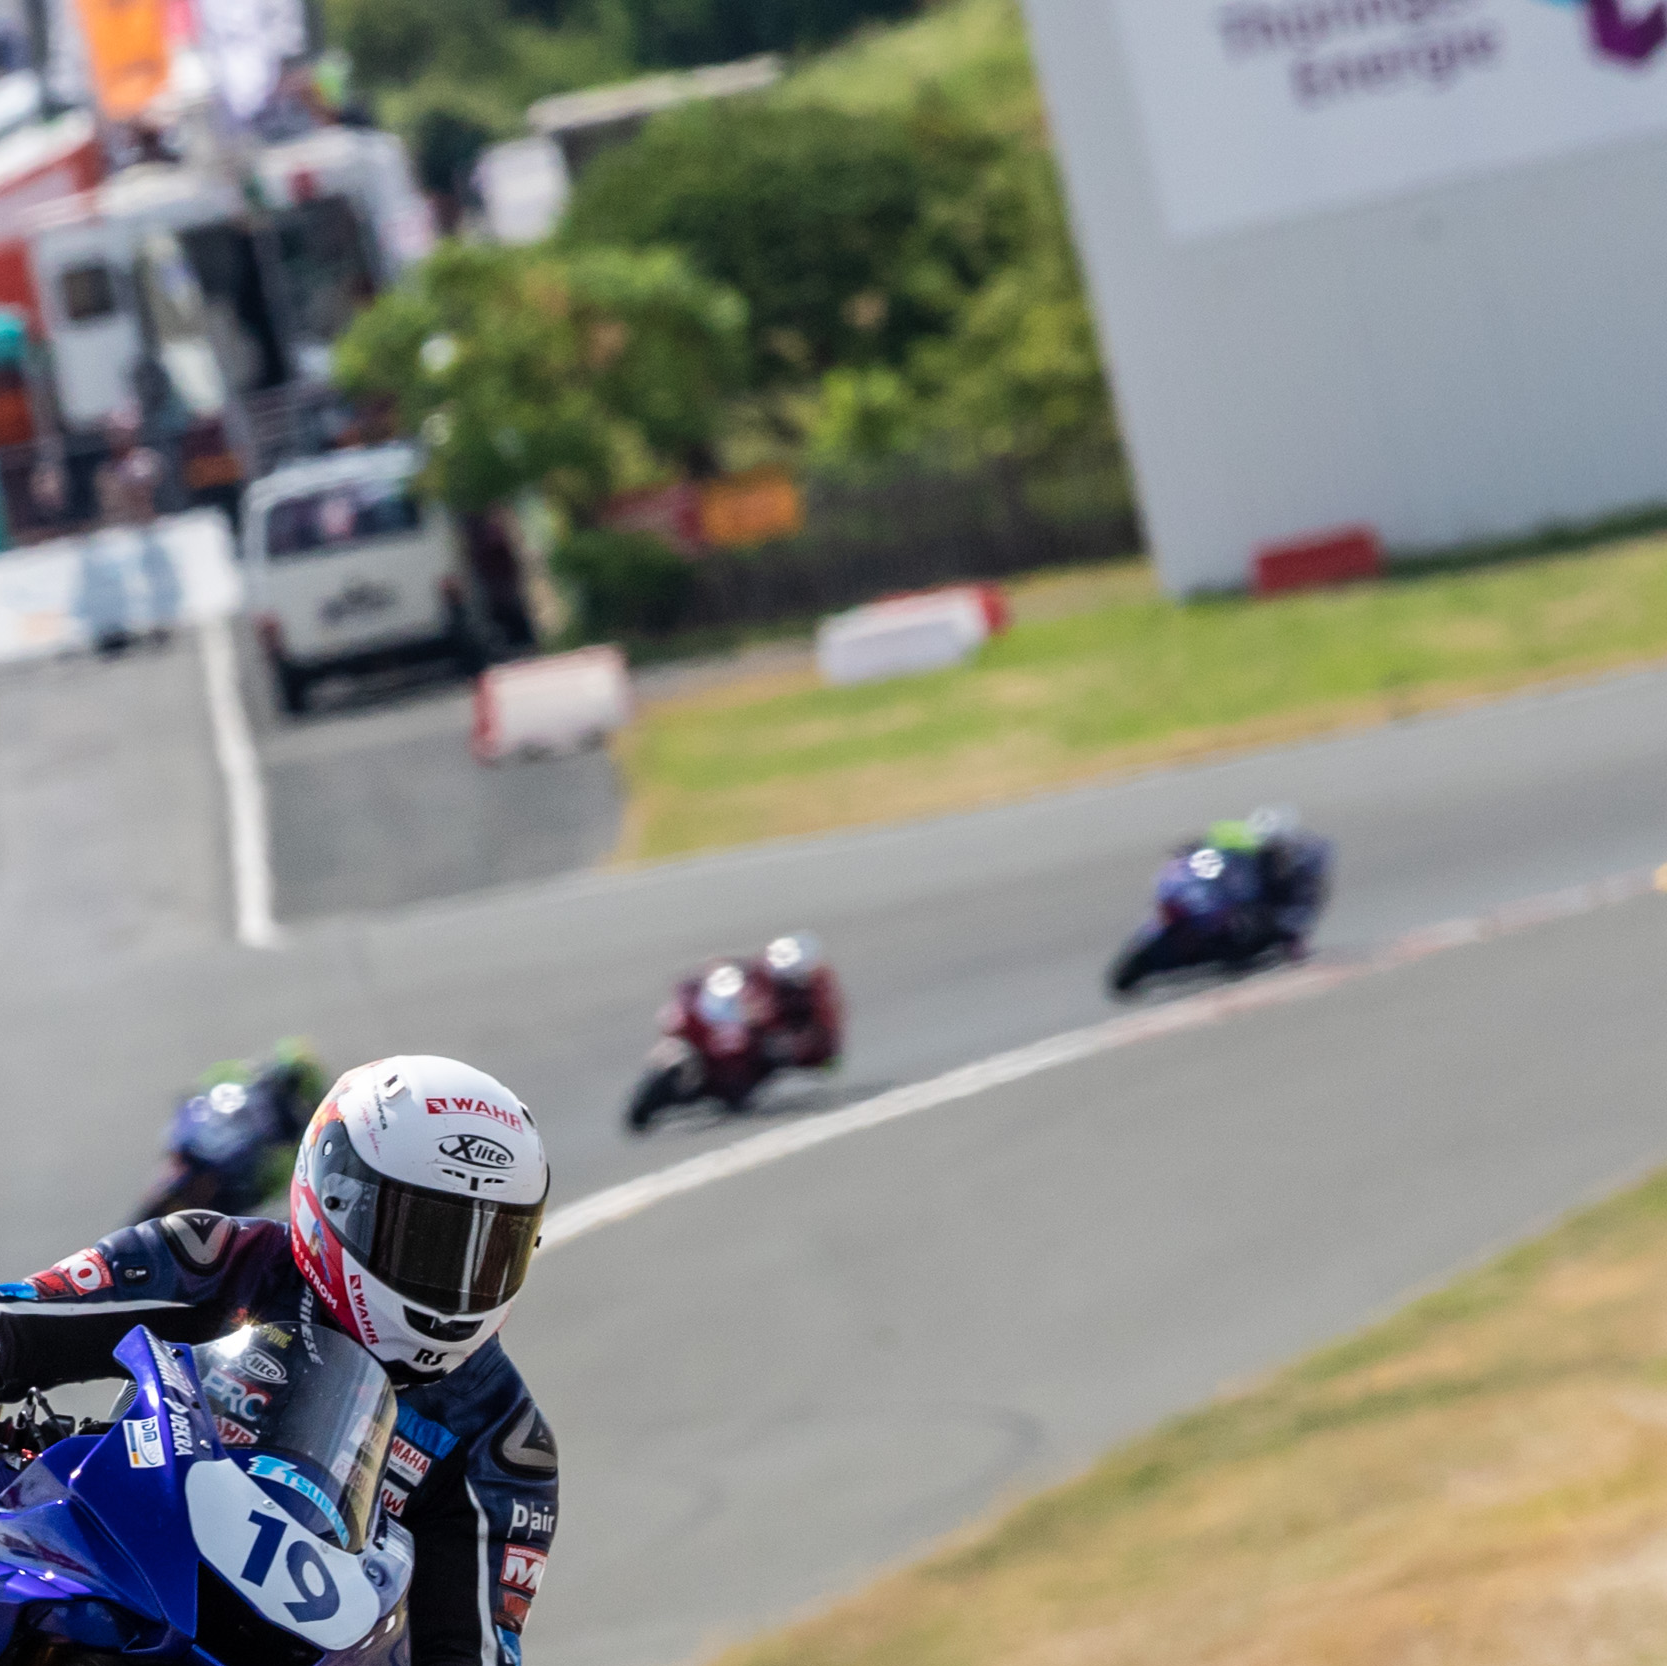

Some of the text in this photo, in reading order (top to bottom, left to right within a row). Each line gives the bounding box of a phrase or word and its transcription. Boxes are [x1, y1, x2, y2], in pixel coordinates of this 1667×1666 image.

[451, 1097, 522, 1131] WAHR
[447, 1135, 508, 1166] X-lite
[302, 1258, 339, 1310] STROM
[298, 1282, 325, 1366] AINESE
[354, 1293, 380, 1346] WAHR
[412, 1347, 450, 1367] RS
[169, 1413, 195, 1457] DEKRA
[391, 1438, 430, 1476] MAHA
[247, 1509, 341, 1624] 19
